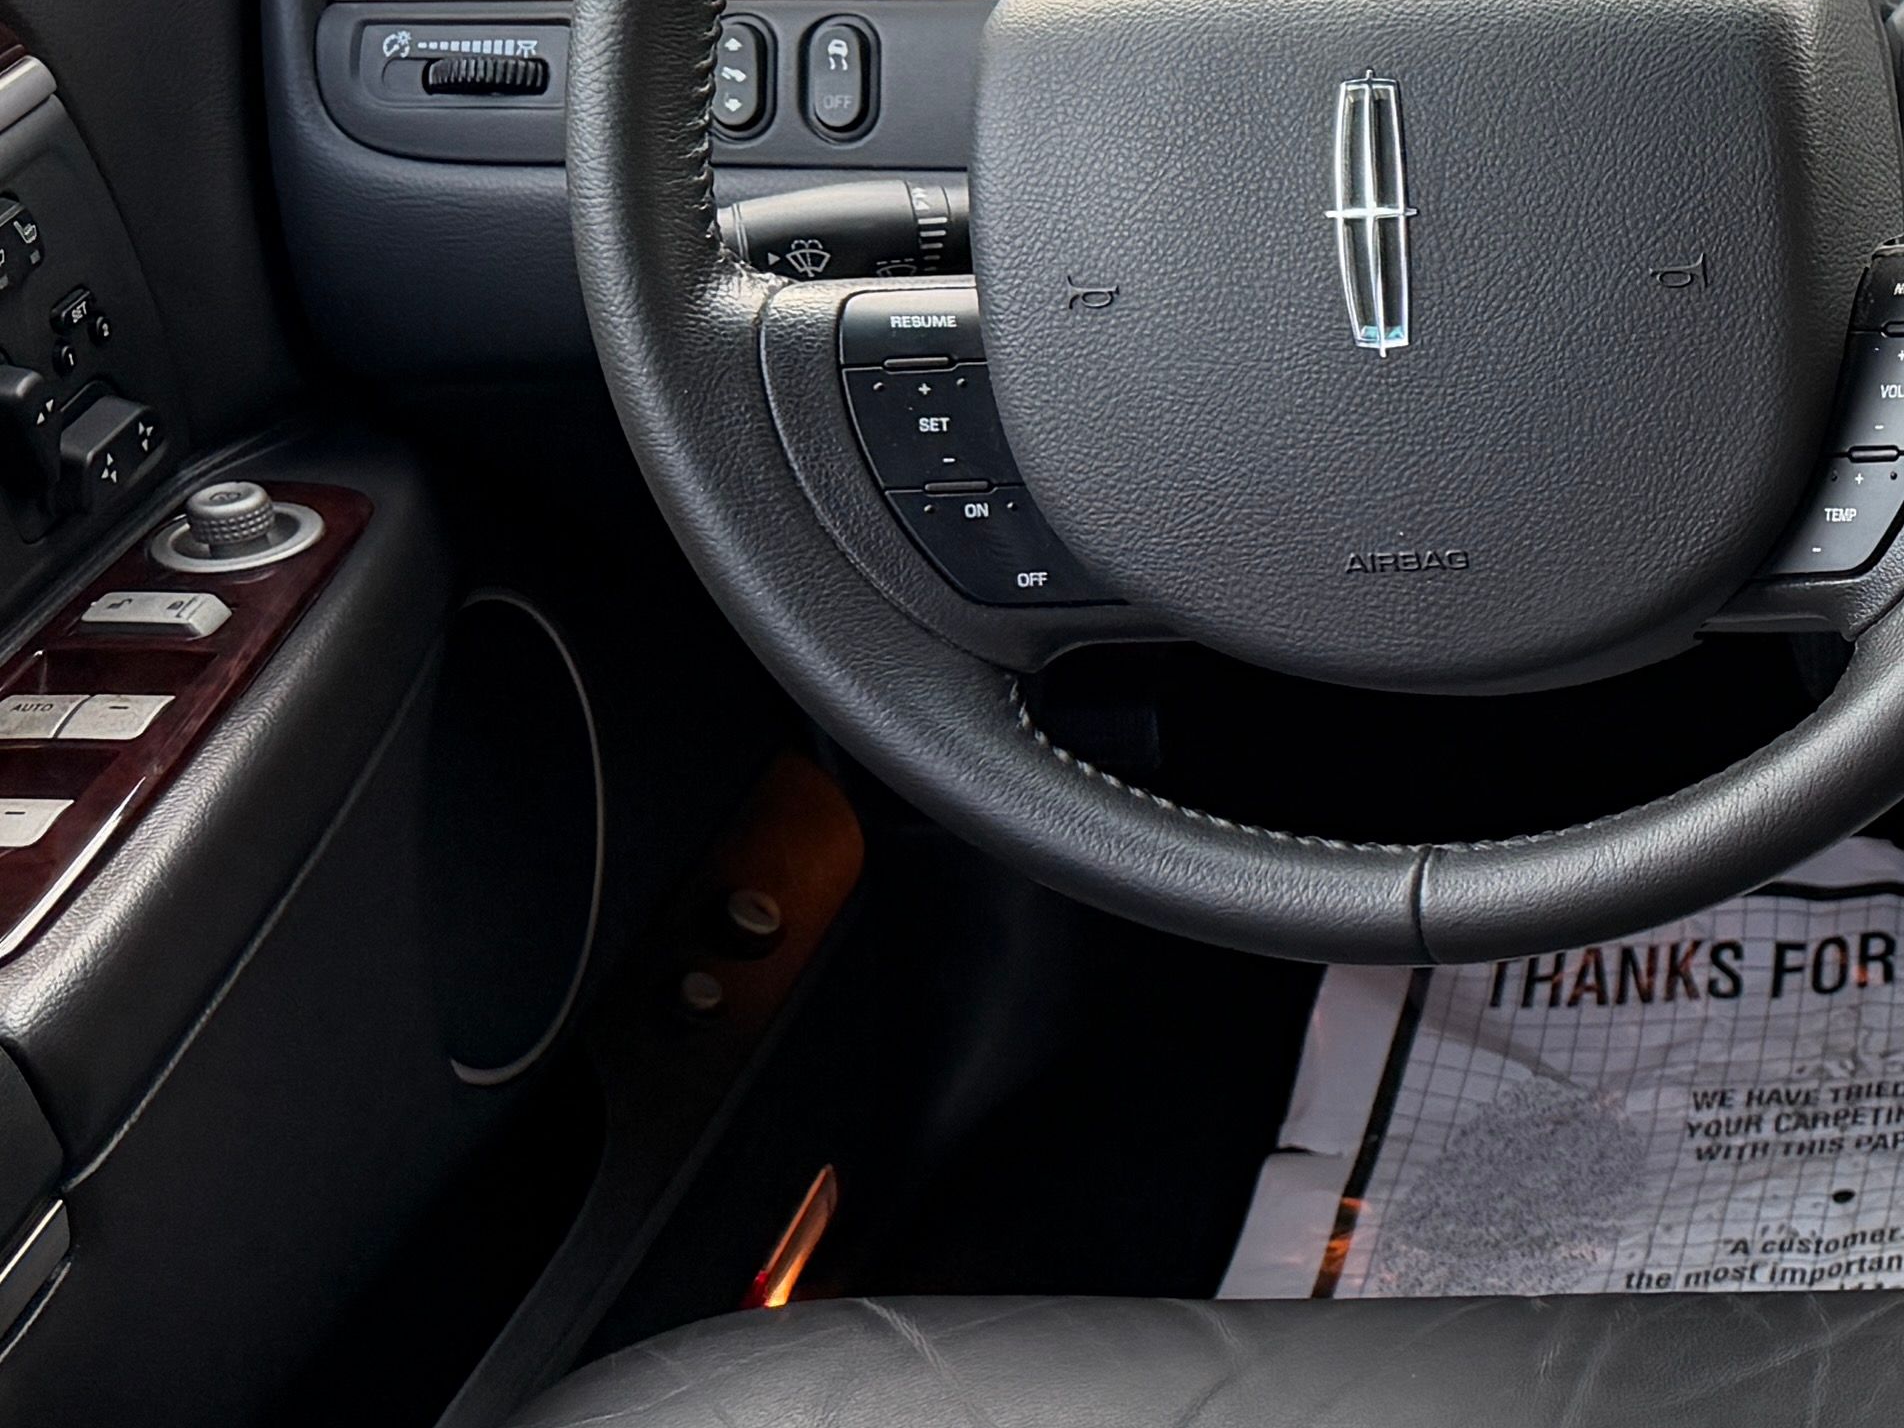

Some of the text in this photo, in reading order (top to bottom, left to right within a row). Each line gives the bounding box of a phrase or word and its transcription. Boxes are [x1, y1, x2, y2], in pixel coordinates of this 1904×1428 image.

[823, 95, 852, 110] OFF
[889, 314, 957, 329] RESUME
[1880, 383, 1904, 399] VOL
[918, 417, 950, 434] SET
[964, 502, 989, 519] ON
[1824, 508, 1857, 523] TEMP
[1346, 549, 1470, 573] AIRBAG
[1017, 572, 1048, 589] OFF
[11, 703, 54, 712] AUTO
[1489, 939, 1744, 1008] THANKS
[1771, 931, 1896, 999] FOR
[1693, 1087, 1737, 1112] WE
[1745, 1084, 1821, 1108] HAVE
[1687, 1118, 1763, 1139] YOUR
[1695, 1142, 1770, 1162] WITH
[1782, 1136, 1845, 1156] THIS
[1761, 1224, 1900, 1255] customer
[1624, 1270, 1673, 1291] the
[1683, 1260, 1758, 1287] most
